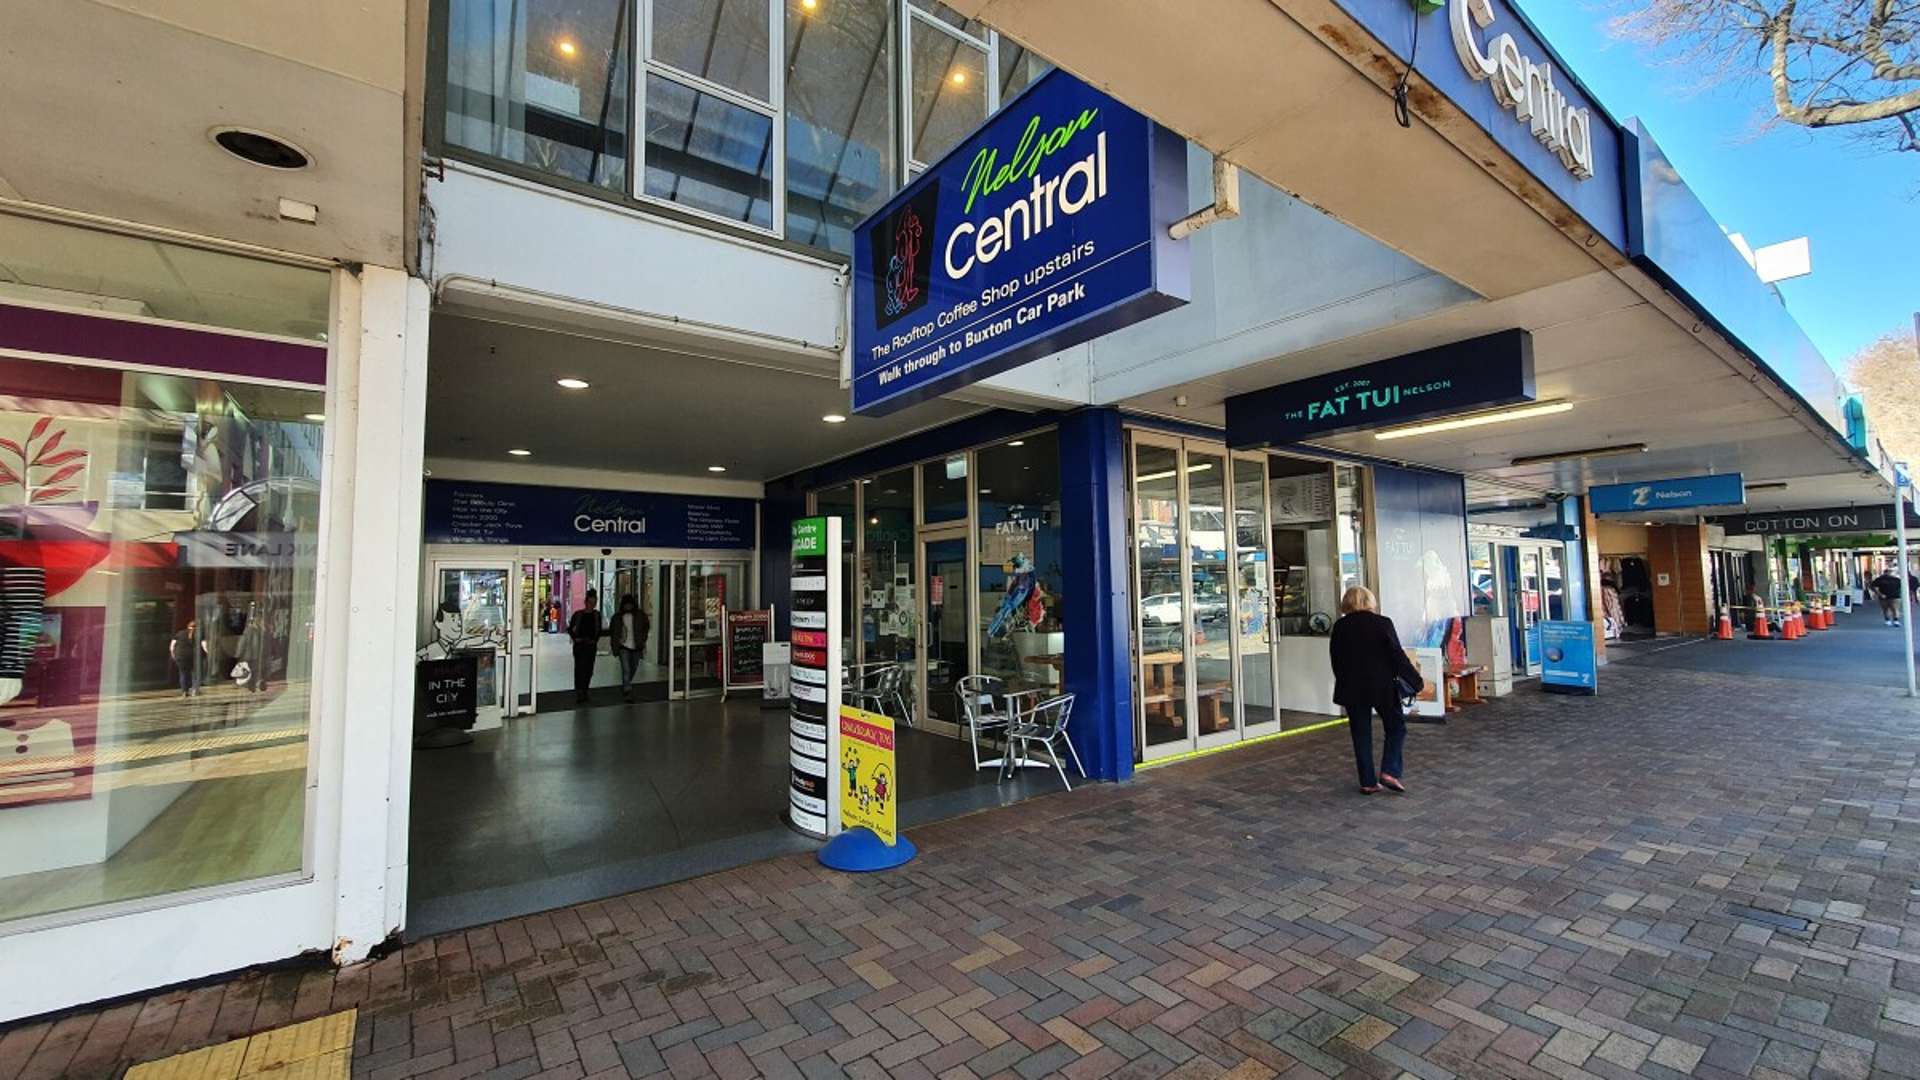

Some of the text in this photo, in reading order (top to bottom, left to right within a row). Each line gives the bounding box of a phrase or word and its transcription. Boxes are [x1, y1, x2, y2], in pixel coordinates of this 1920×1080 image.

[961, 107, 1098, 214] Nelson
[944, 131, 1107, 279] Central
[872, 240, 1095, 360] The Rooftop Coffee Shop upstairs
[879, 282, 1086, 386] Walk through to Buxton Car Park
[1285, 380, 1451, 421] THE FAT TUI NELSON
[1655, 489, 1693, 500] Nelson
[573, 514, 646, 534] Central
[995, 517, 1040, 536] FAT TUI
[1744, 514, 1859, 533] COTTON ON
[428, 677, 466, 704] IN THE CITY
